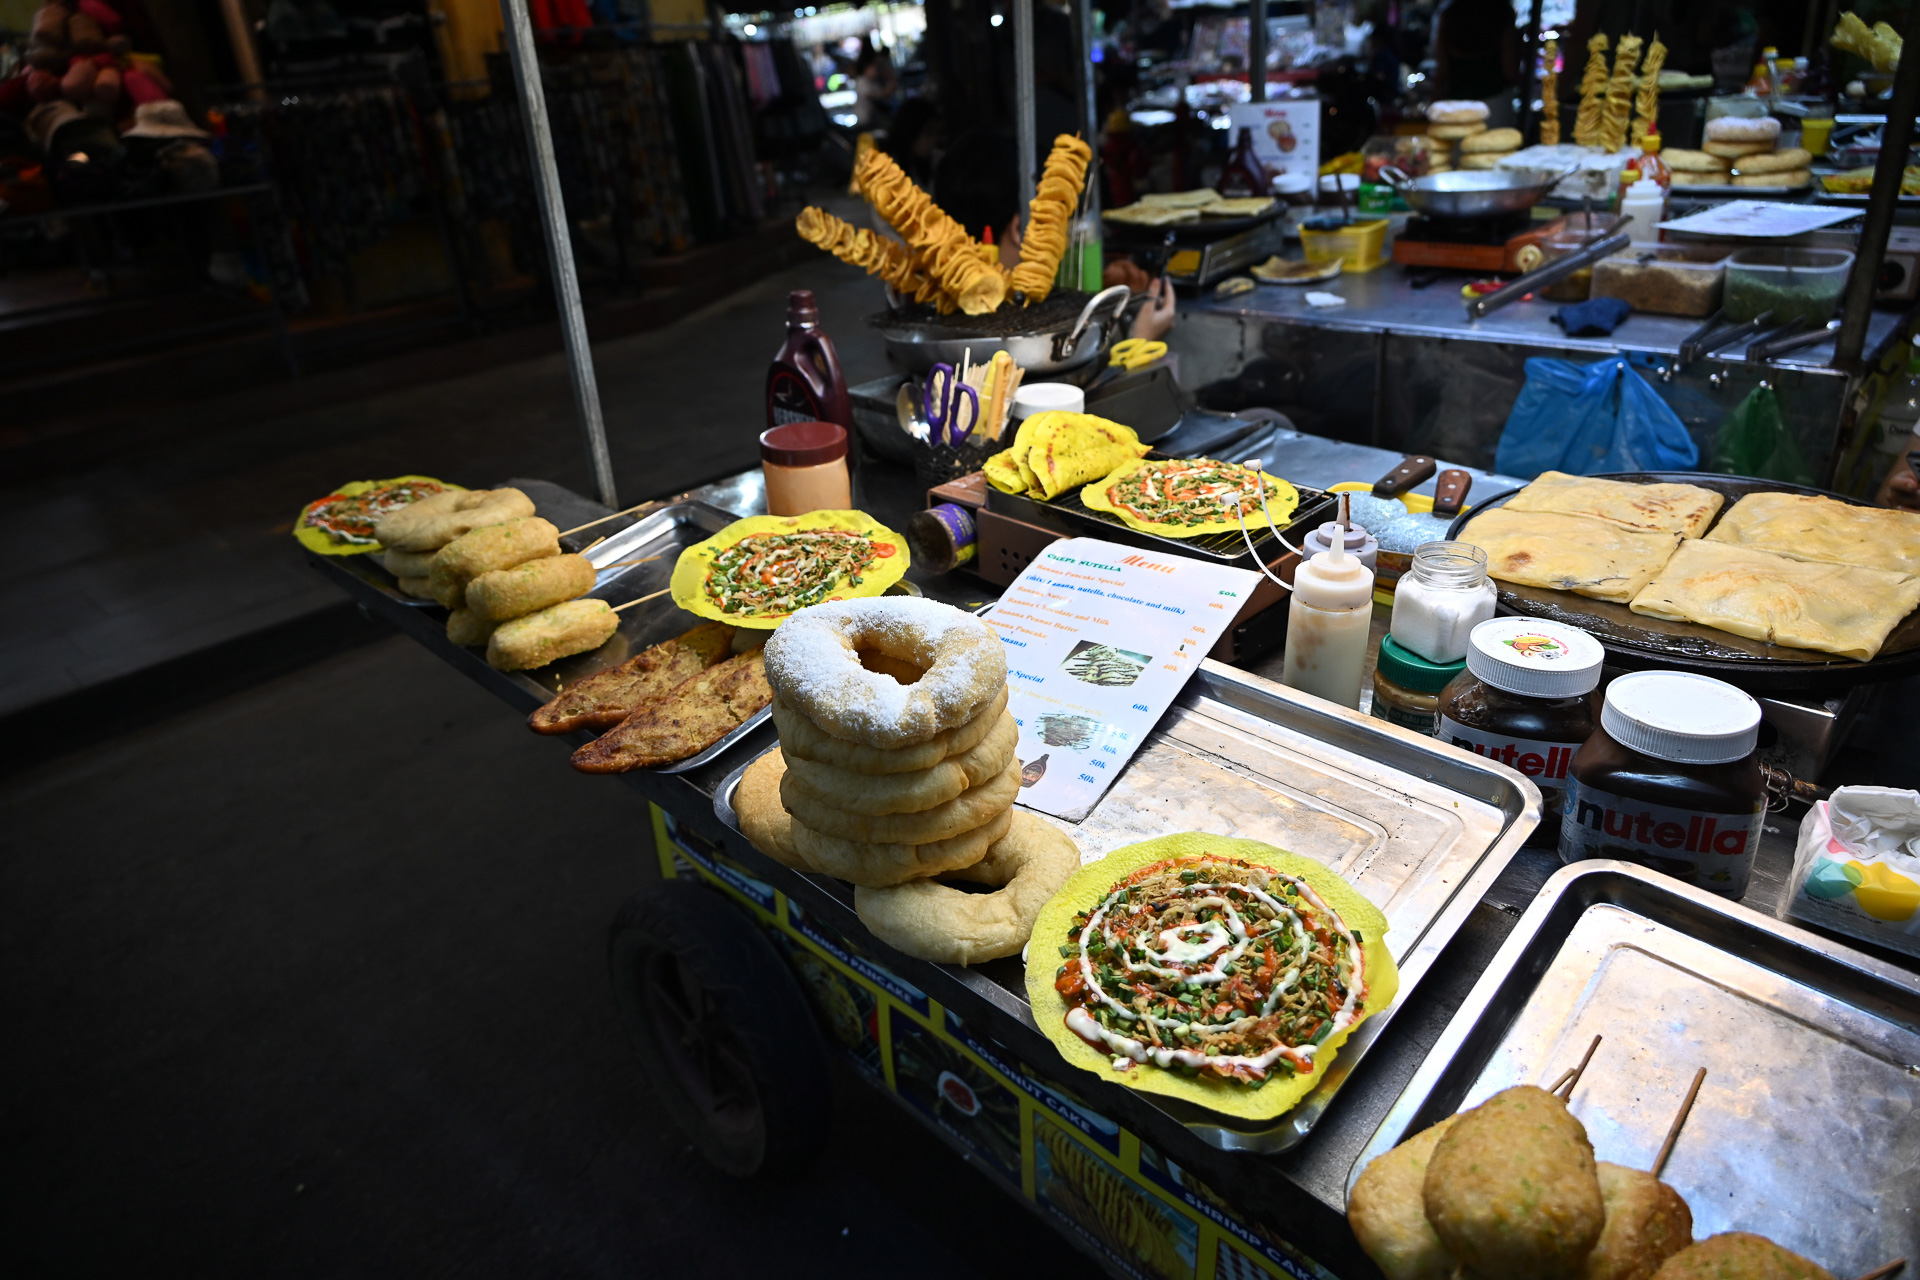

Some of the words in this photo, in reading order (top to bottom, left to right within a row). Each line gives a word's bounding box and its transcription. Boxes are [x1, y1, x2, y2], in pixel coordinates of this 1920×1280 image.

[1080, 559, 1122, 572] NUTELLA
[1114, 554, 1176, 574] Menu
[1036, 564, 1064, 576] Banana
[1065, 571, 1096, 582] Pancake
[1098, 577, 1126, 587] Special
[1016, 585, 1045, 598] Banana
[1047, 592, 1073, 603] Nutela
[1077, 585, 1106, 597] nutella,
[1107, 591, 1145, 605] chocolate
[1145, 601, 1162, 610] and
[1162, 605, 1186, 616] milk)
[997, 608, 1025, 619] Banana
[1025, 614, 1053, 626] Peanut
[1053, 622, 1080, 633] Butter
[1007, 597, 1035, 609] Banana
[1074, 612, 1090, 622] and
[1092, 616, 1111, 627] Milk
[986, 618, 1014, 630] Banana
[1015, 625, 1048, 639] Pancake
[1013, 668, 1045, 684] Special
[1132, 703, 1150, 713] 60k
[1100, 744, 1118, 755] 50k
[1452, 735, 1571, 779] nutell
[1088, 758, 1107, 769] 50k
[1077, 773, 1096, 784] 50k
[1576, 799, 1748, 855] nutella
[801, 924, 849, 963] MANGO
[850, 957, 912, 1005] PANCAKE
[966, 1037, 1043, 1098] COCONUT
[1045, 1096, 1091, 1134] CAKE
[1184, 1191, 1263, 1247] SHRIMP
[1266, 1246, 1316, 1280] CAK
